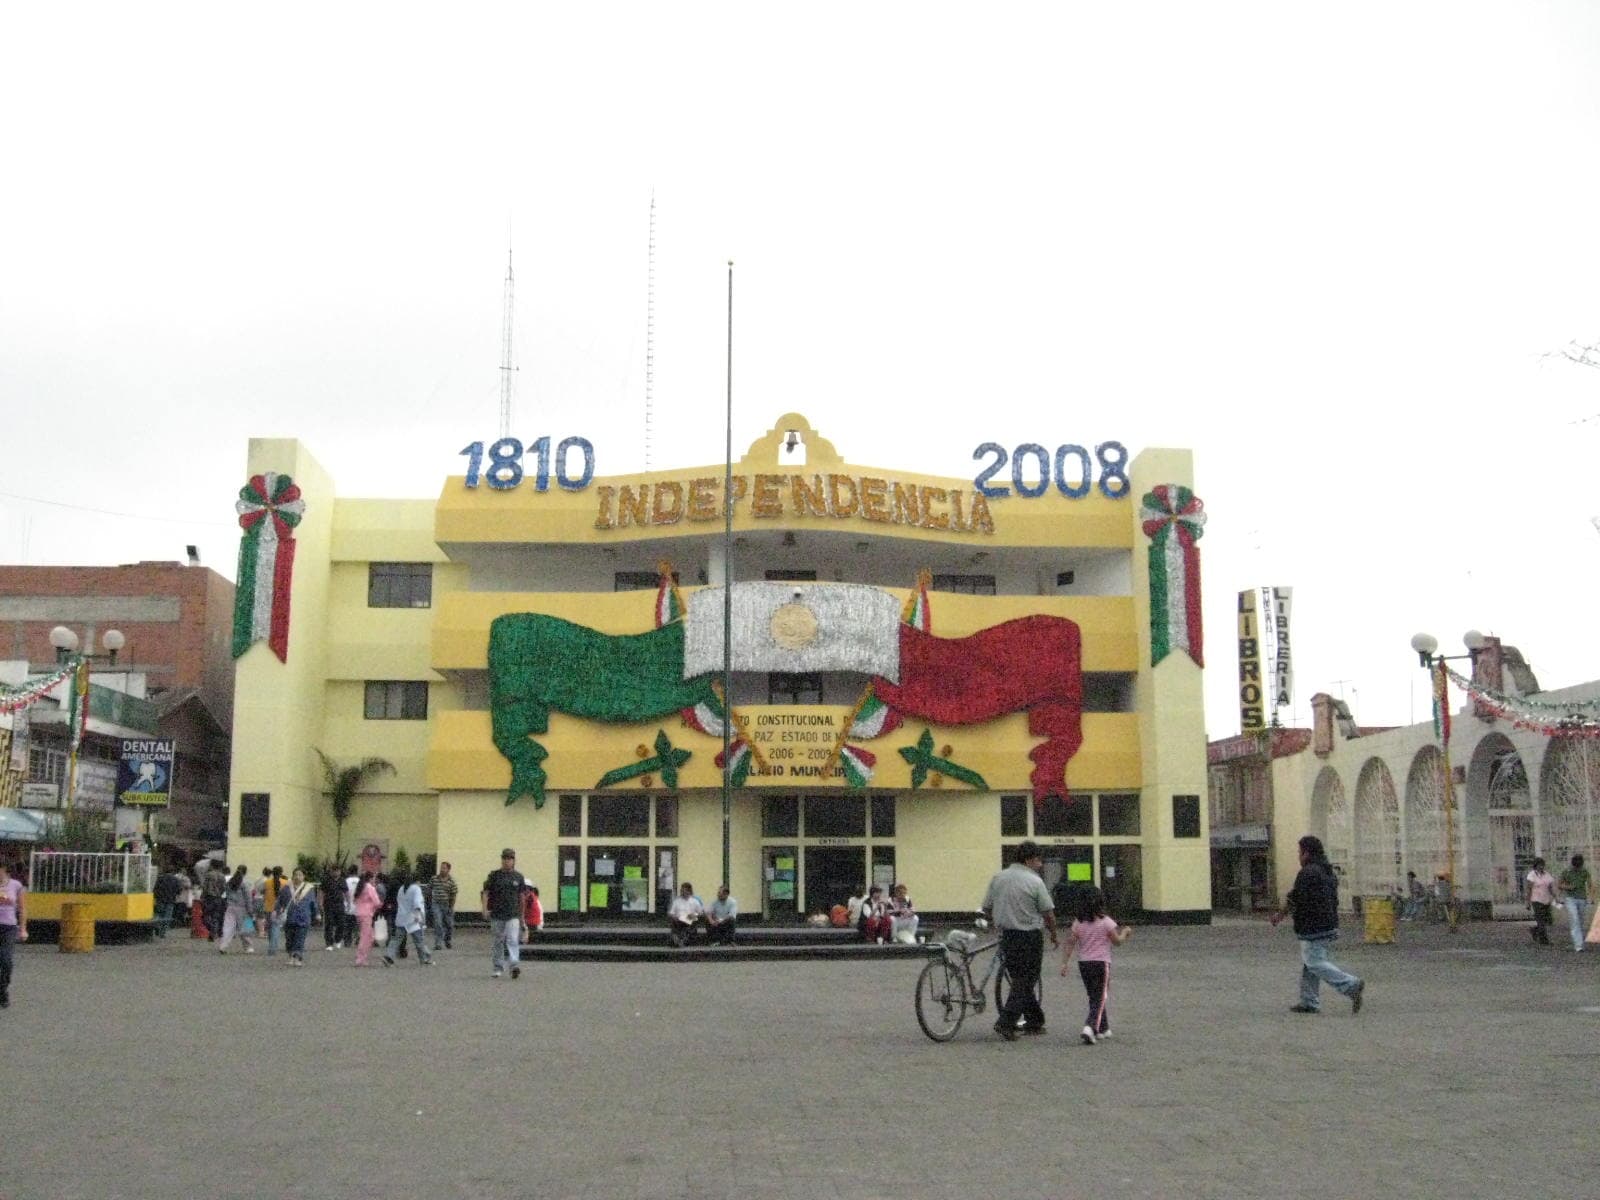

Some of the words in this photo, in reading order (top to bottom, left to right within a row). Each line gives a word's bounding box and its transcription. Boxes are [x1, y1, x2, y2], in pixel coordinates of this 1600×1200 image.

[459, 436, 595, 492] 1810
[973, 441, 1131, 500] 2008
[594, 474, 995, 536] INDEPENDENCIA
[1238, 591, 1263, 728] LIBROS
[1273, 586, 1290, 706] LIBRERIA
[754, 731, 774, 742] PAZ
[782, 731, 818, 742] ESTADO
[822, 731, 832, 742] DE
[757, 714, 835, 726] CONSTITUCIONAL
[121, 752, 173, 762] AMERICANA
[122, 740, 171, 753] DENTAL
[769, 748, 794, 760] 2006
